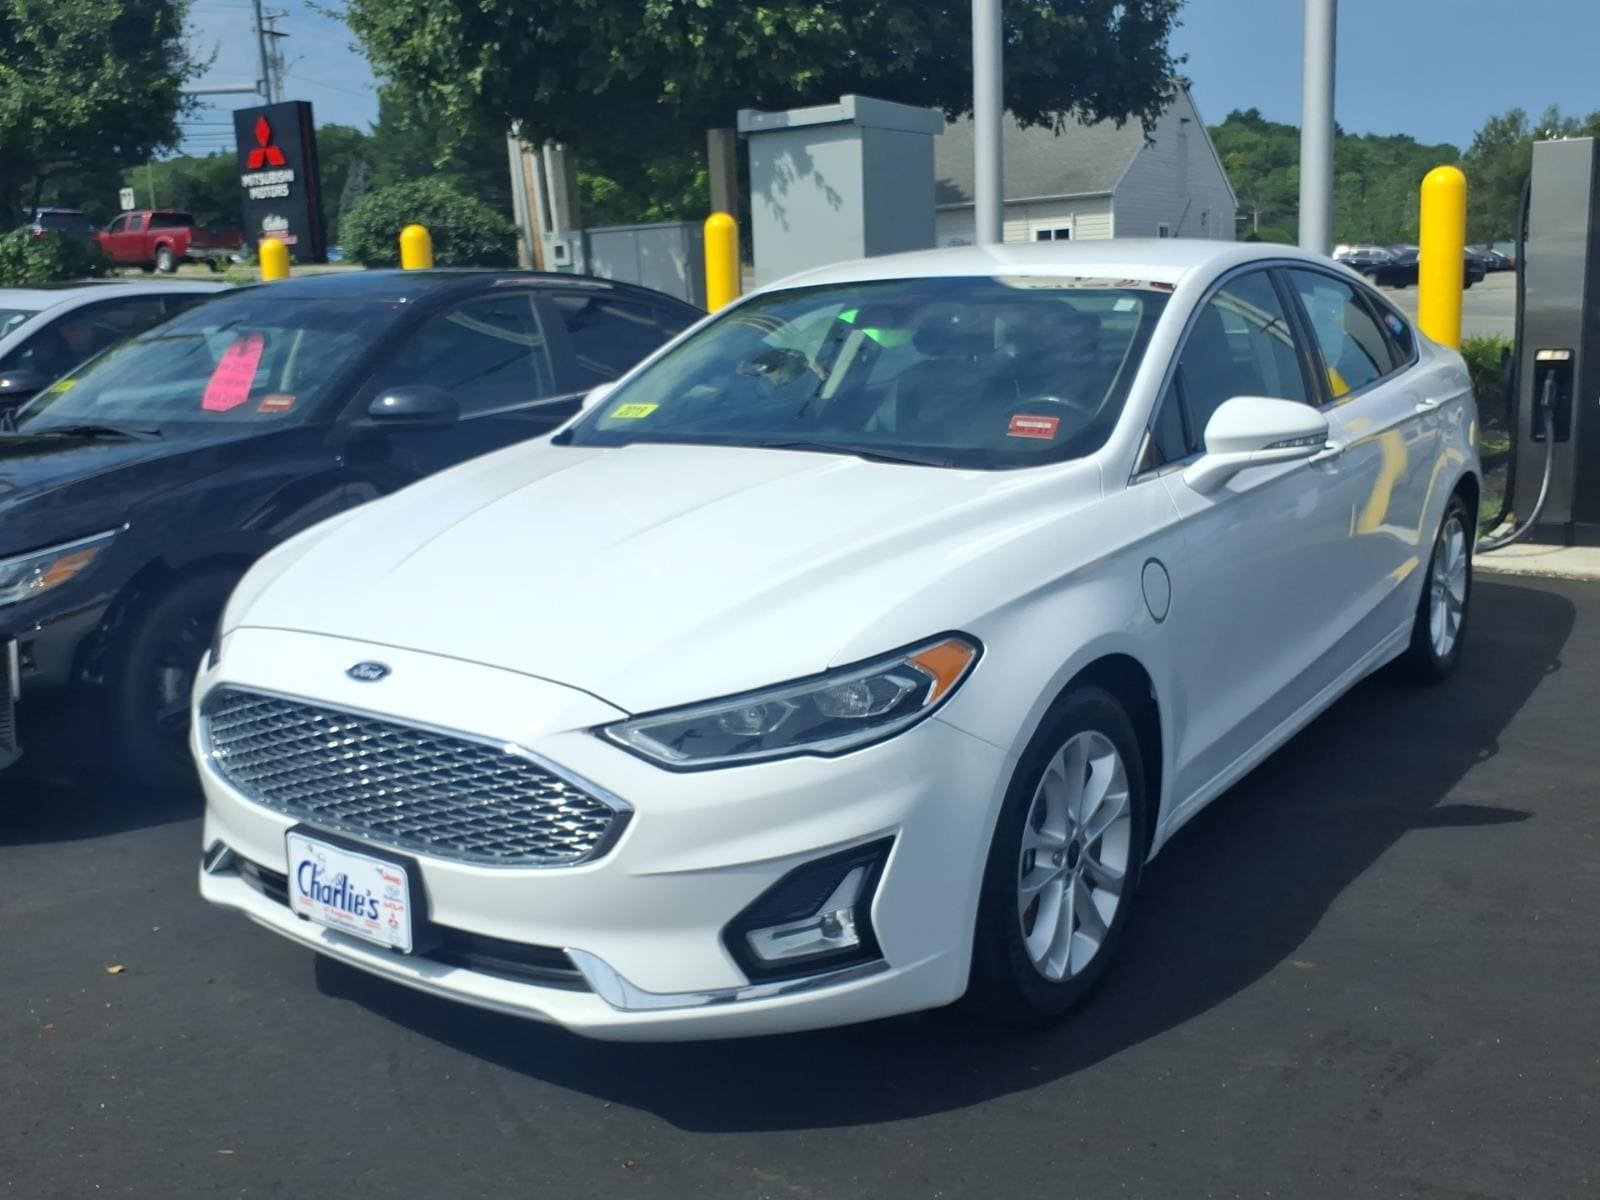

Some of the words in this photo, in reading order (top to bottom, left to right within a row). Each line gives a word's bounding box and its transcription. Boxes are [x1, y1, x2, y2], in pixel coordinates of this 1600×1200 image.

[241, 168, 295, 188] MITSUBISHI
[249, 183, 290, 200] MOTORS
[297, 859, 380, 920] Charlie's
